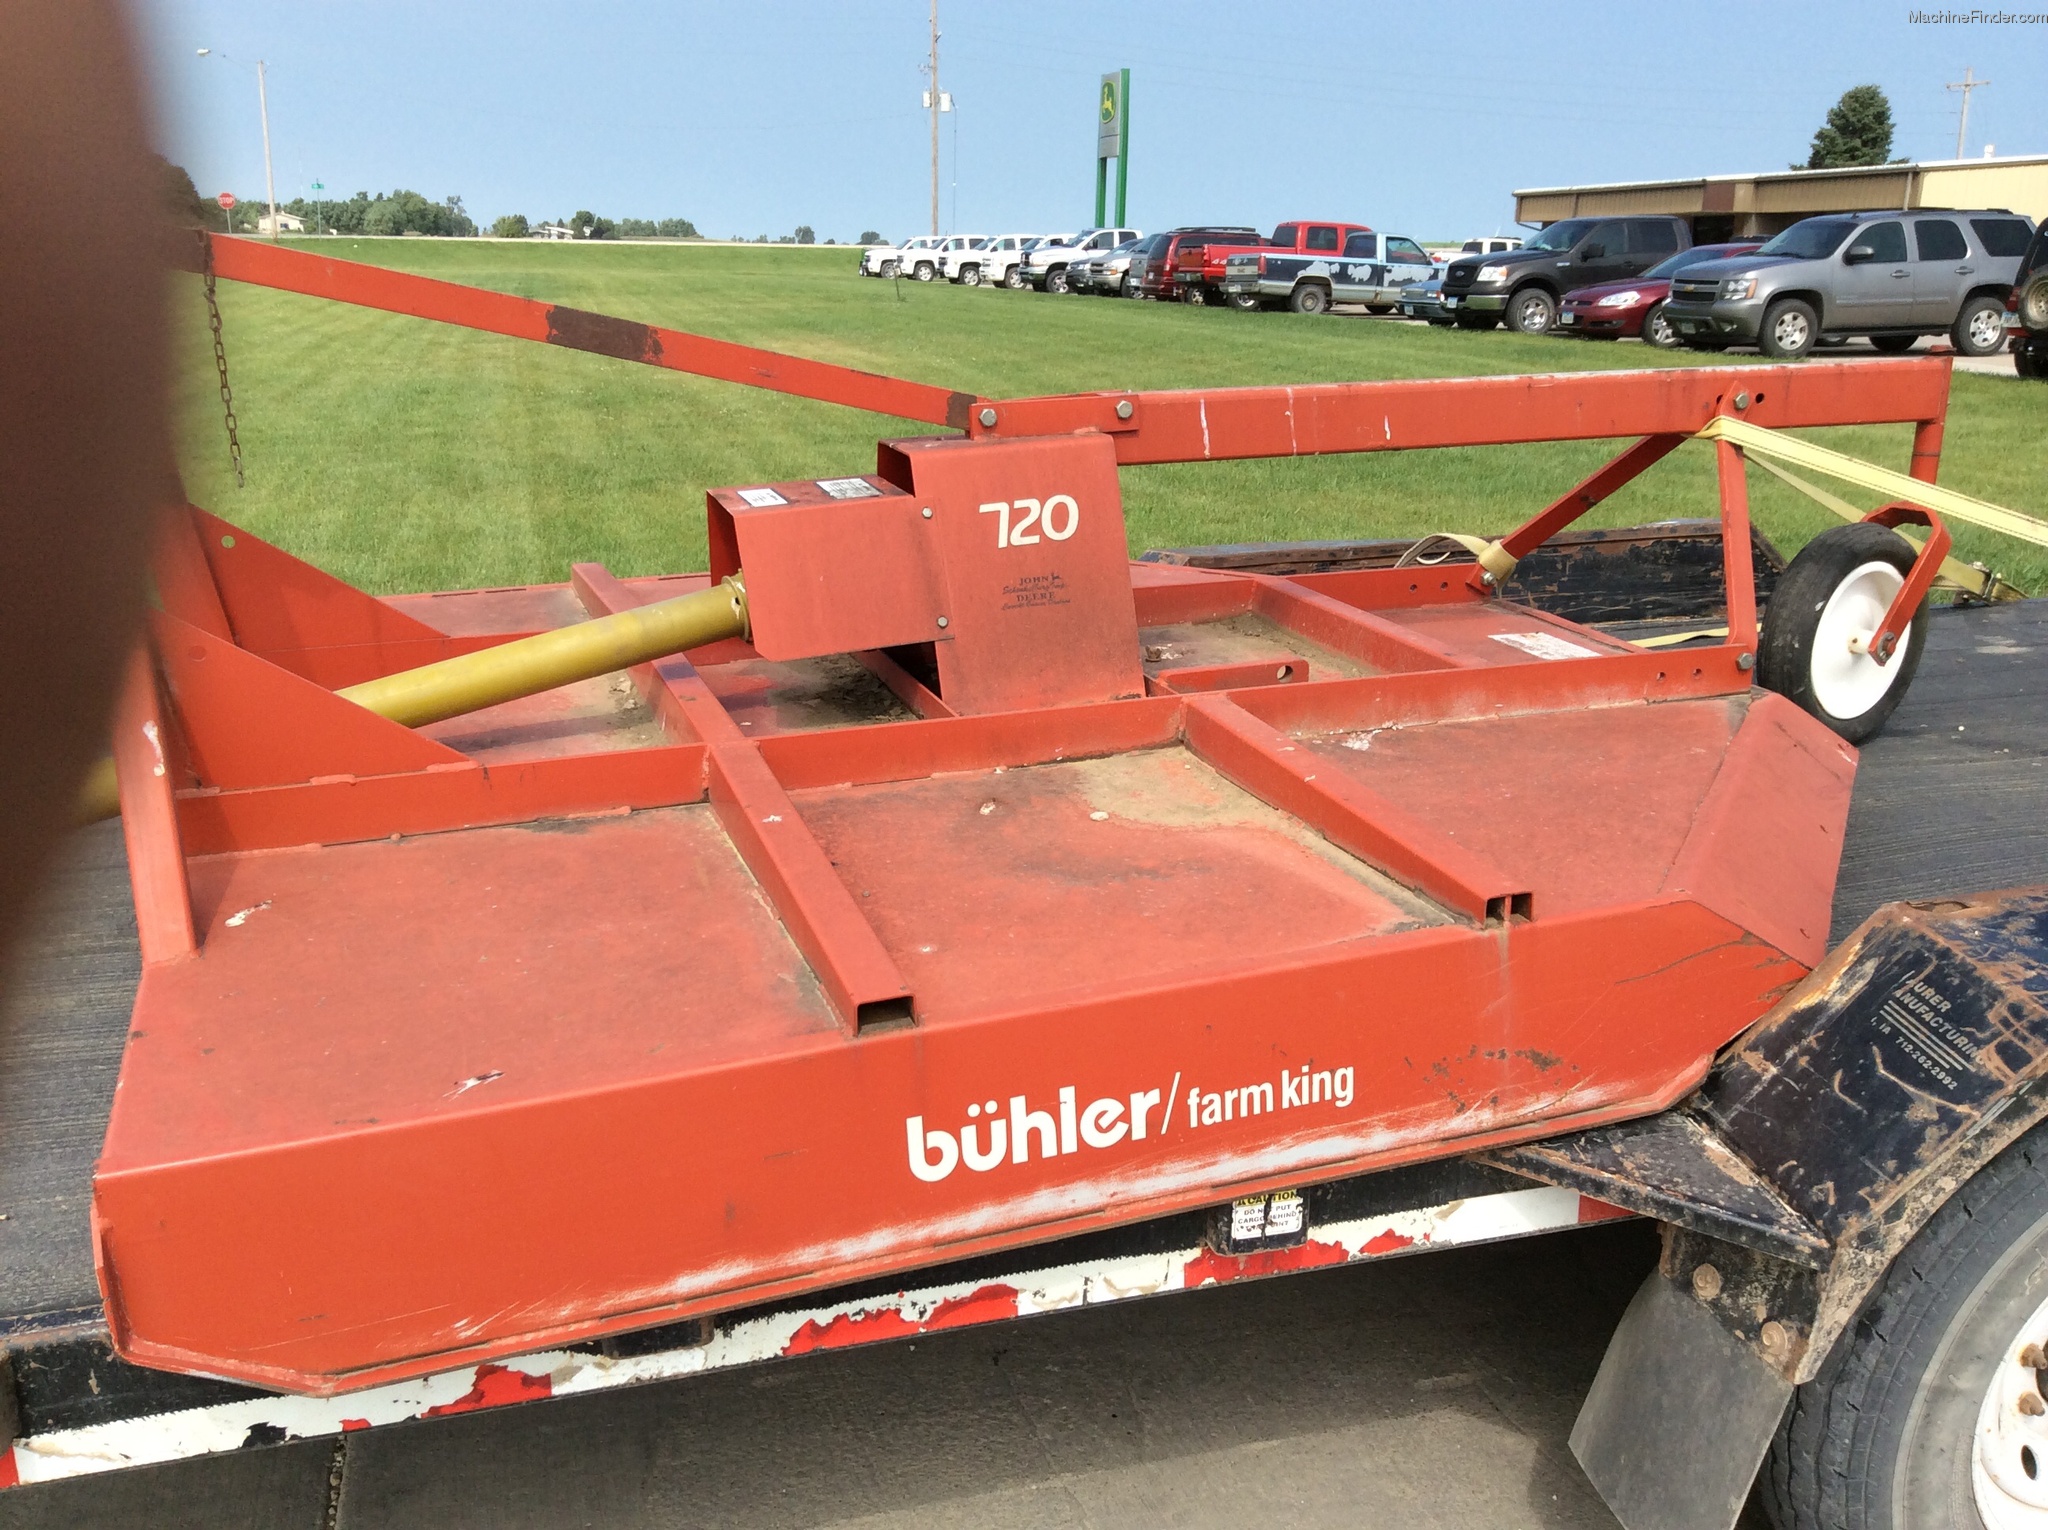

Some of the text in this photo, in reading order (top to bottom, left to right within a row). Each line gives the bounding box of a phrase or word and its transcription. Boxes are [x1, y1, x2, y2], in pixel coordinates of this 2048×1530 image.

[979, 494, 1079, 549] 720
[1019, 575, 1049, 586] JOHN
[1016, 592, 1055, 601] DEERE
[1187, 1080, 1273, 1129] farm
[1282, 1065, 1355, 1109] king
[1244, 1208, 1256, 1216] DO
